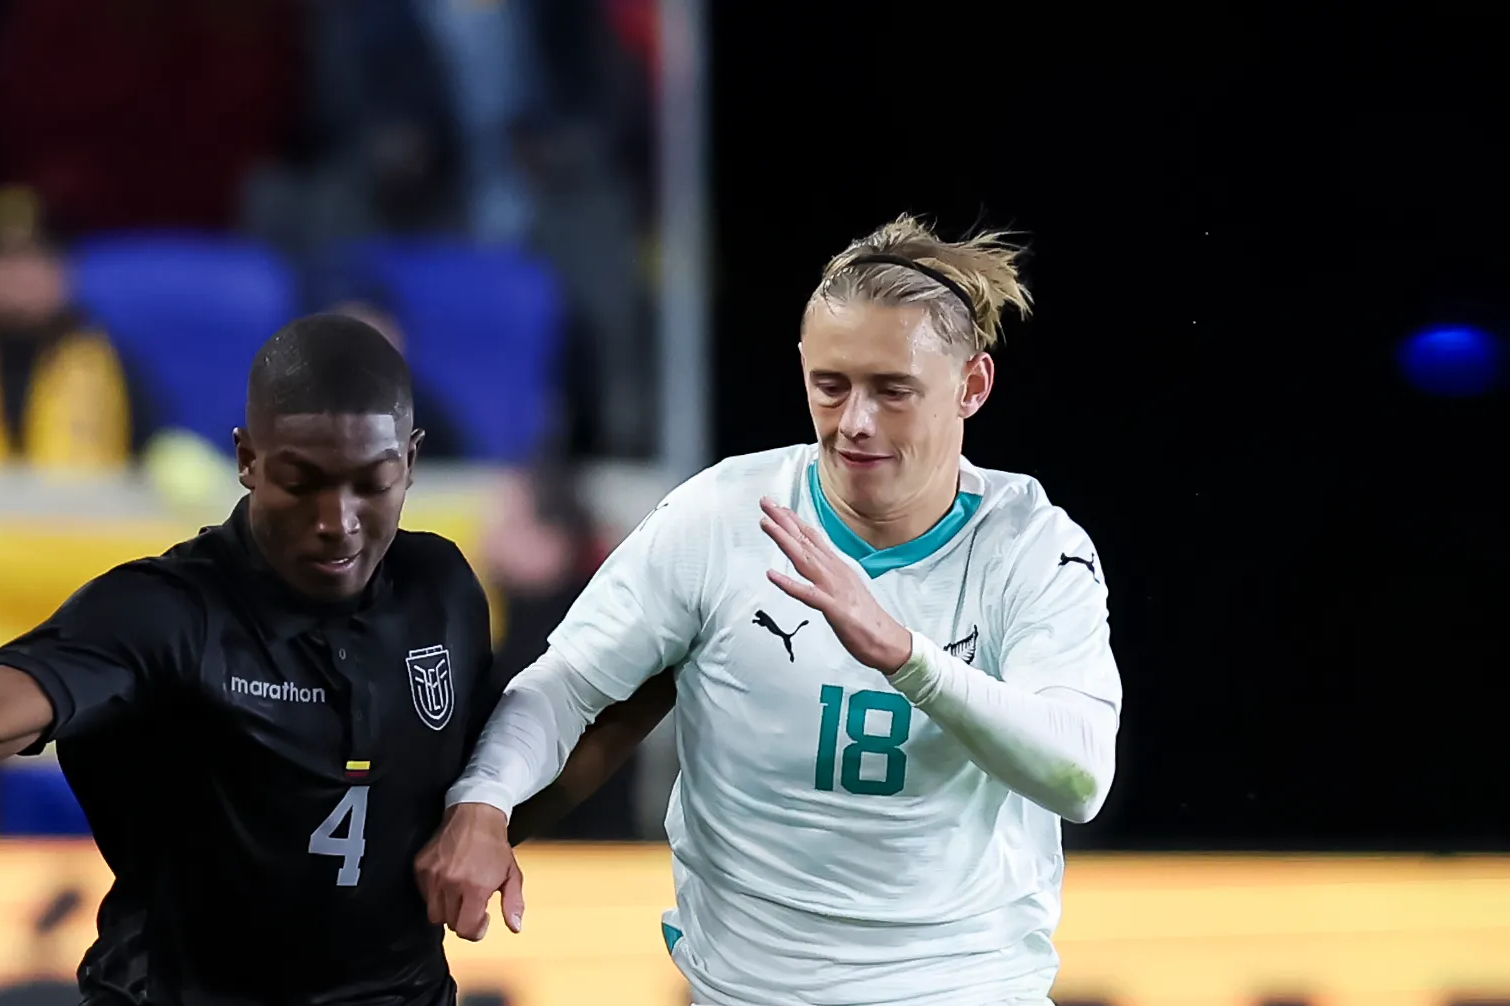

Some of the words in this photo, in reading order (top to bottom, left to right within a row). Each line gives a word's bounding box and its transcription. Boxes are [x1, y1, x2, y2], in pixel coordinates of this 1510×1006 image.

[231, 675, 326, 703] marathon
[814, 684, 913, 797] 18
[307, 785, 371, 887] 4
